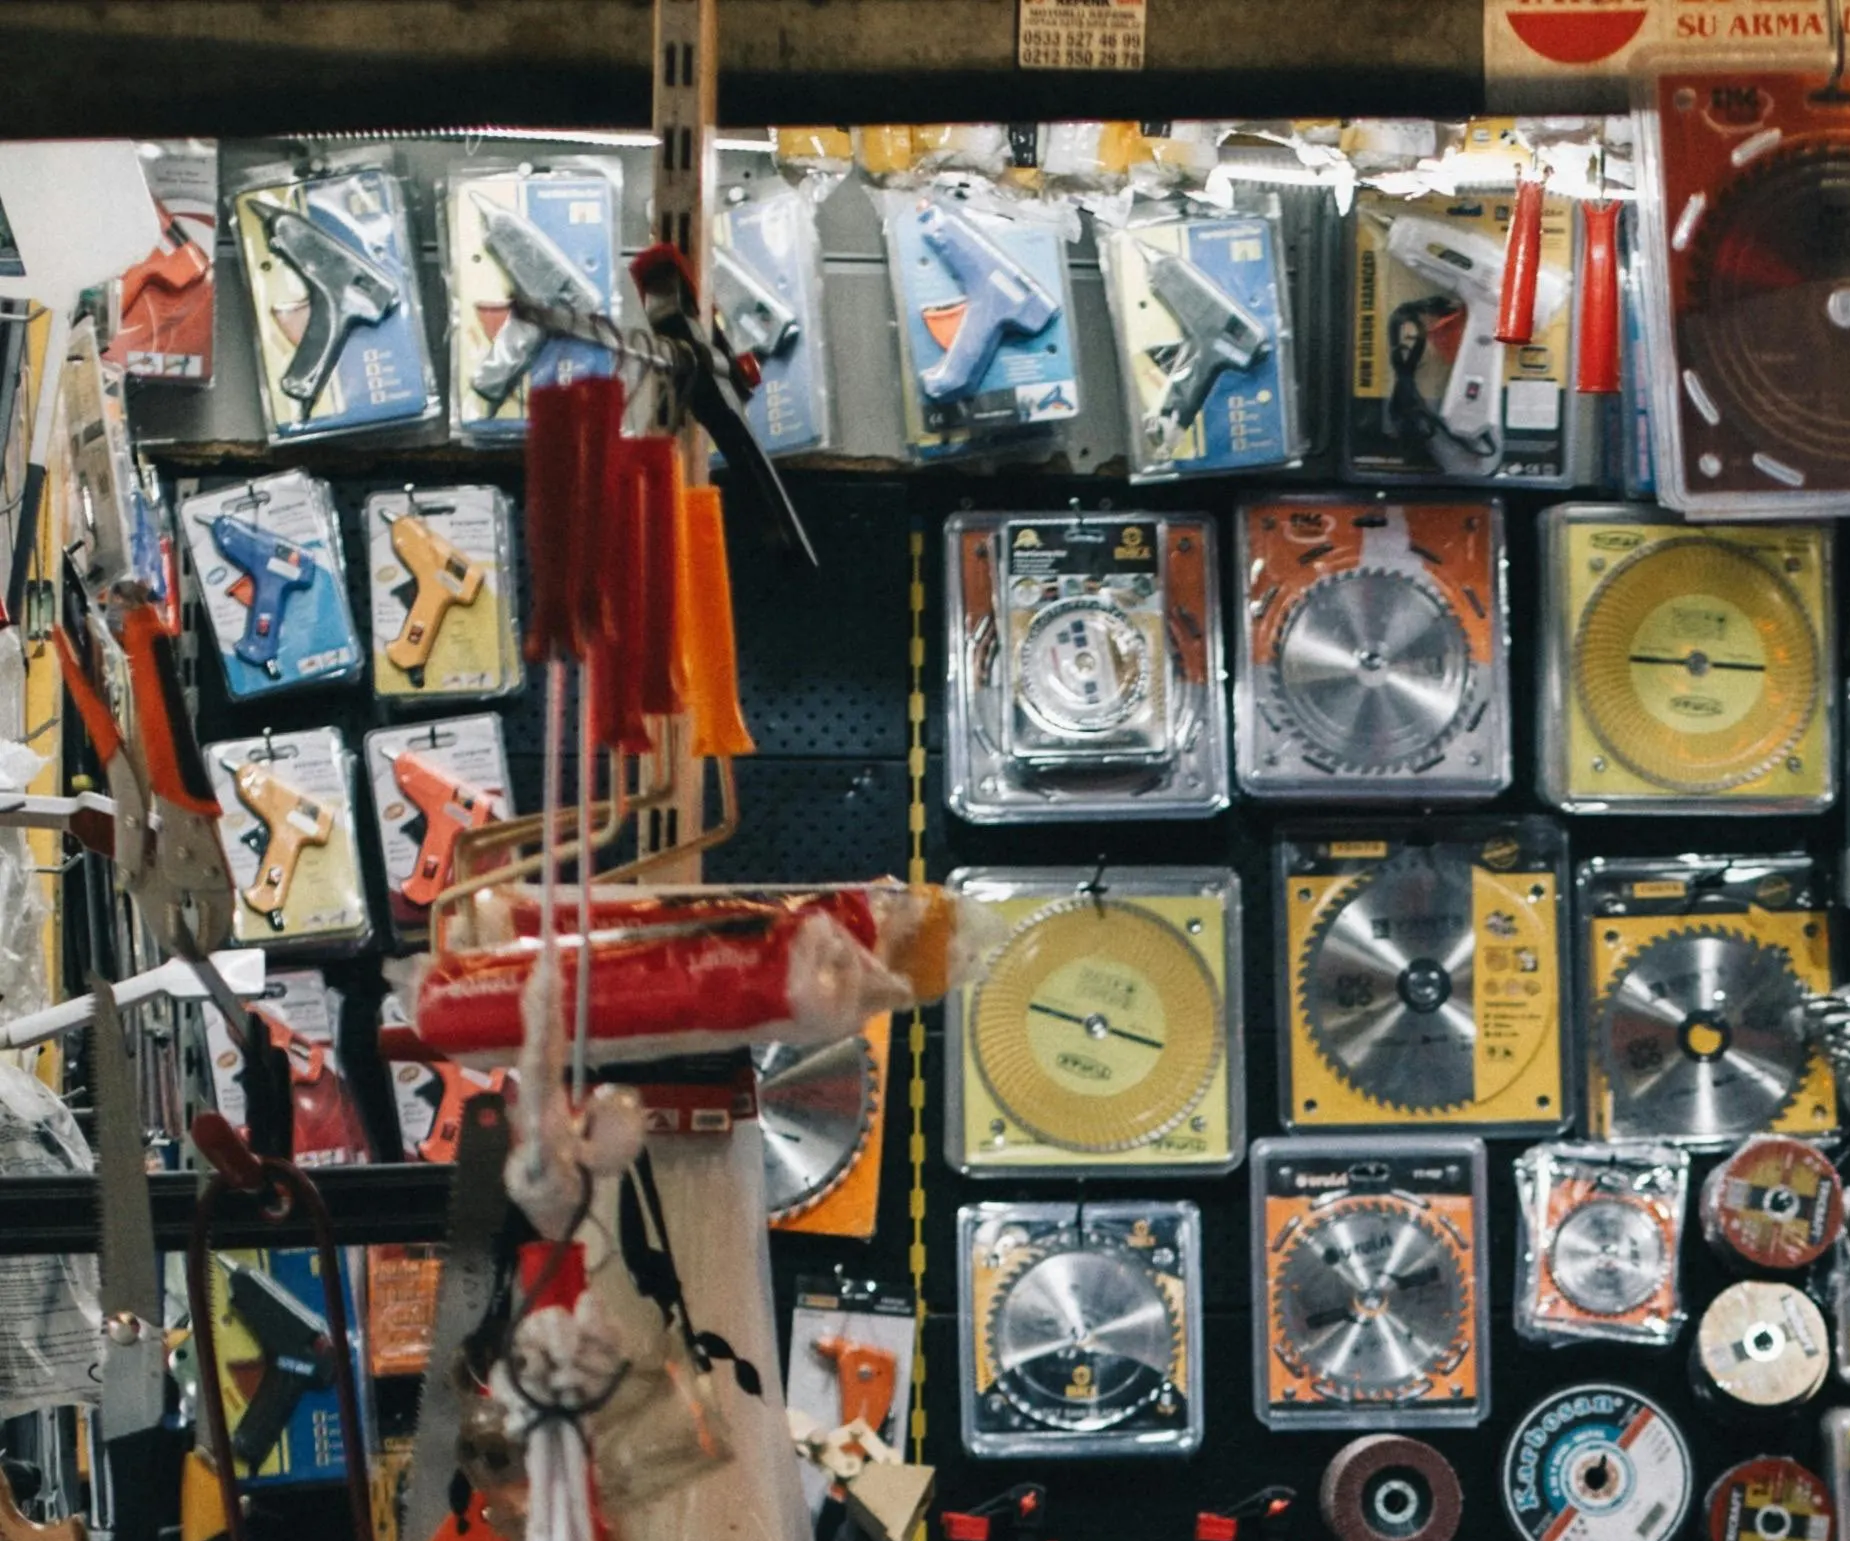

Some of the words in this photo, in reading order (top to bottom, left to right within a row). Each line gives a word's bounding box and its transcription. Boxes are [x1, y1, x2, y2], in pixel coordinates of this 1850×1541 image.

[1676, 12, 1717, 37] SU
[1023, 49, 1060, 64] 0212
[1513, 1394, 1615, 1512] Karbosan
